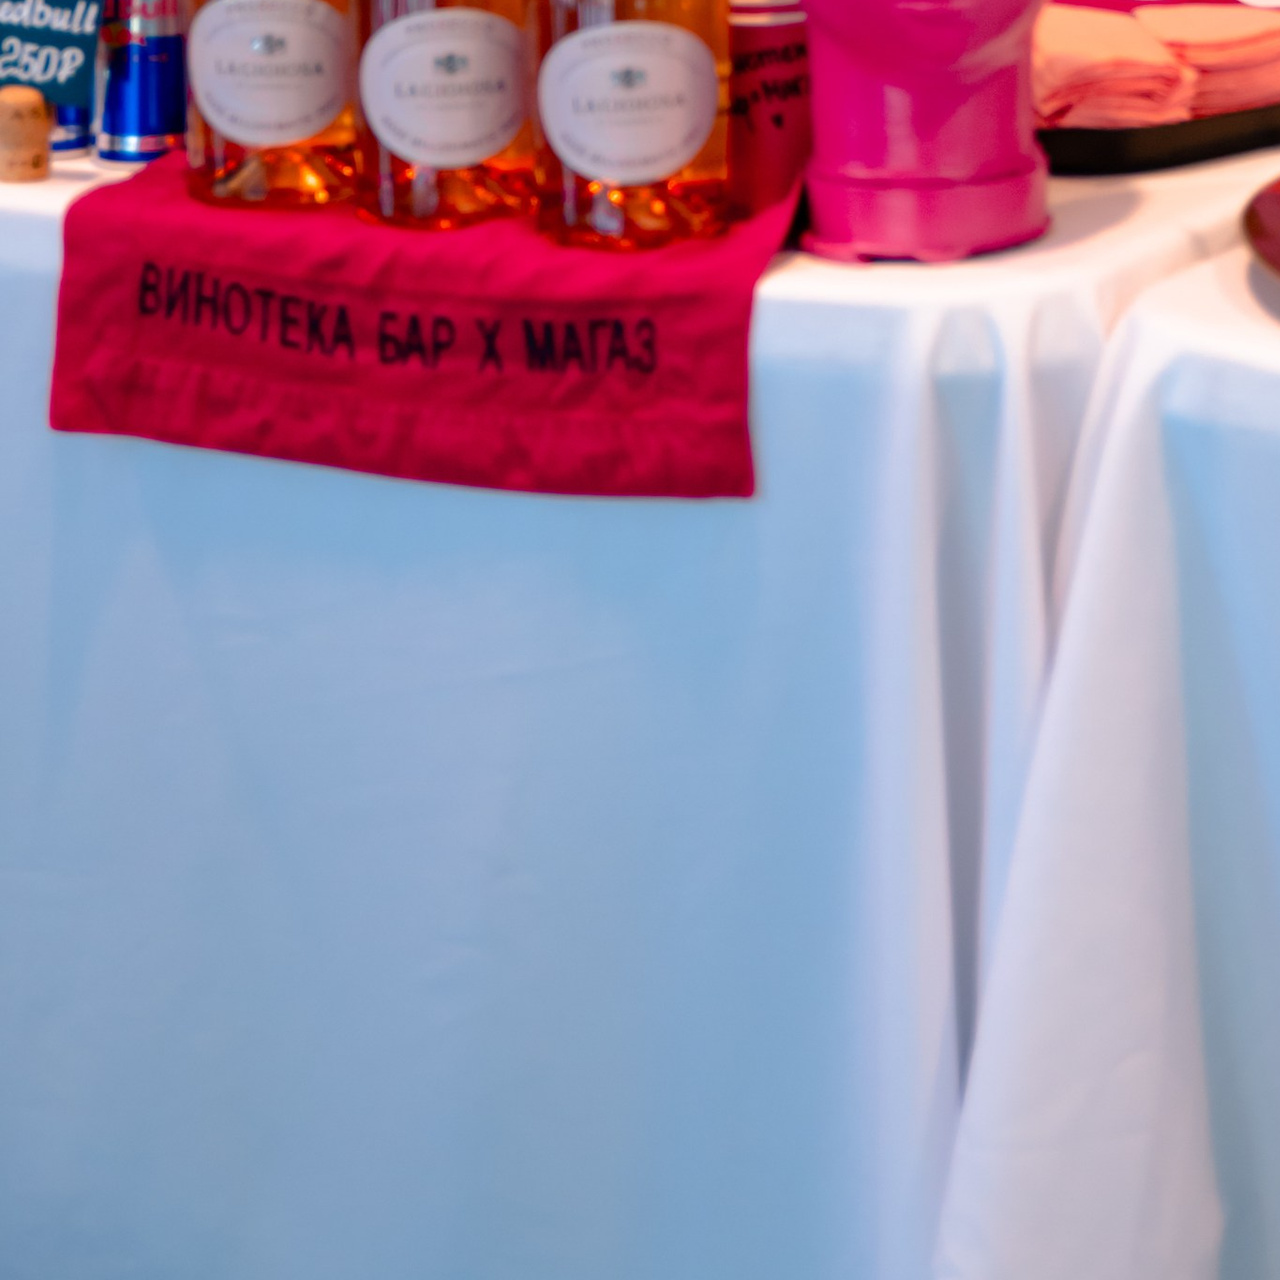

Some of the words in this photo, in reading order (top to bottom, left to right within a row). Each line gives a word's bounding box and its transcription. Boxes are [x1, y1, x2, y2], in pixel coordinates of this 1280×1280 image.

[138, 260, 356, 361] ВИНОТЕКА
[378, 311, 457, 370] БАР
[522, 316, 656, 375] МАГАЗ
